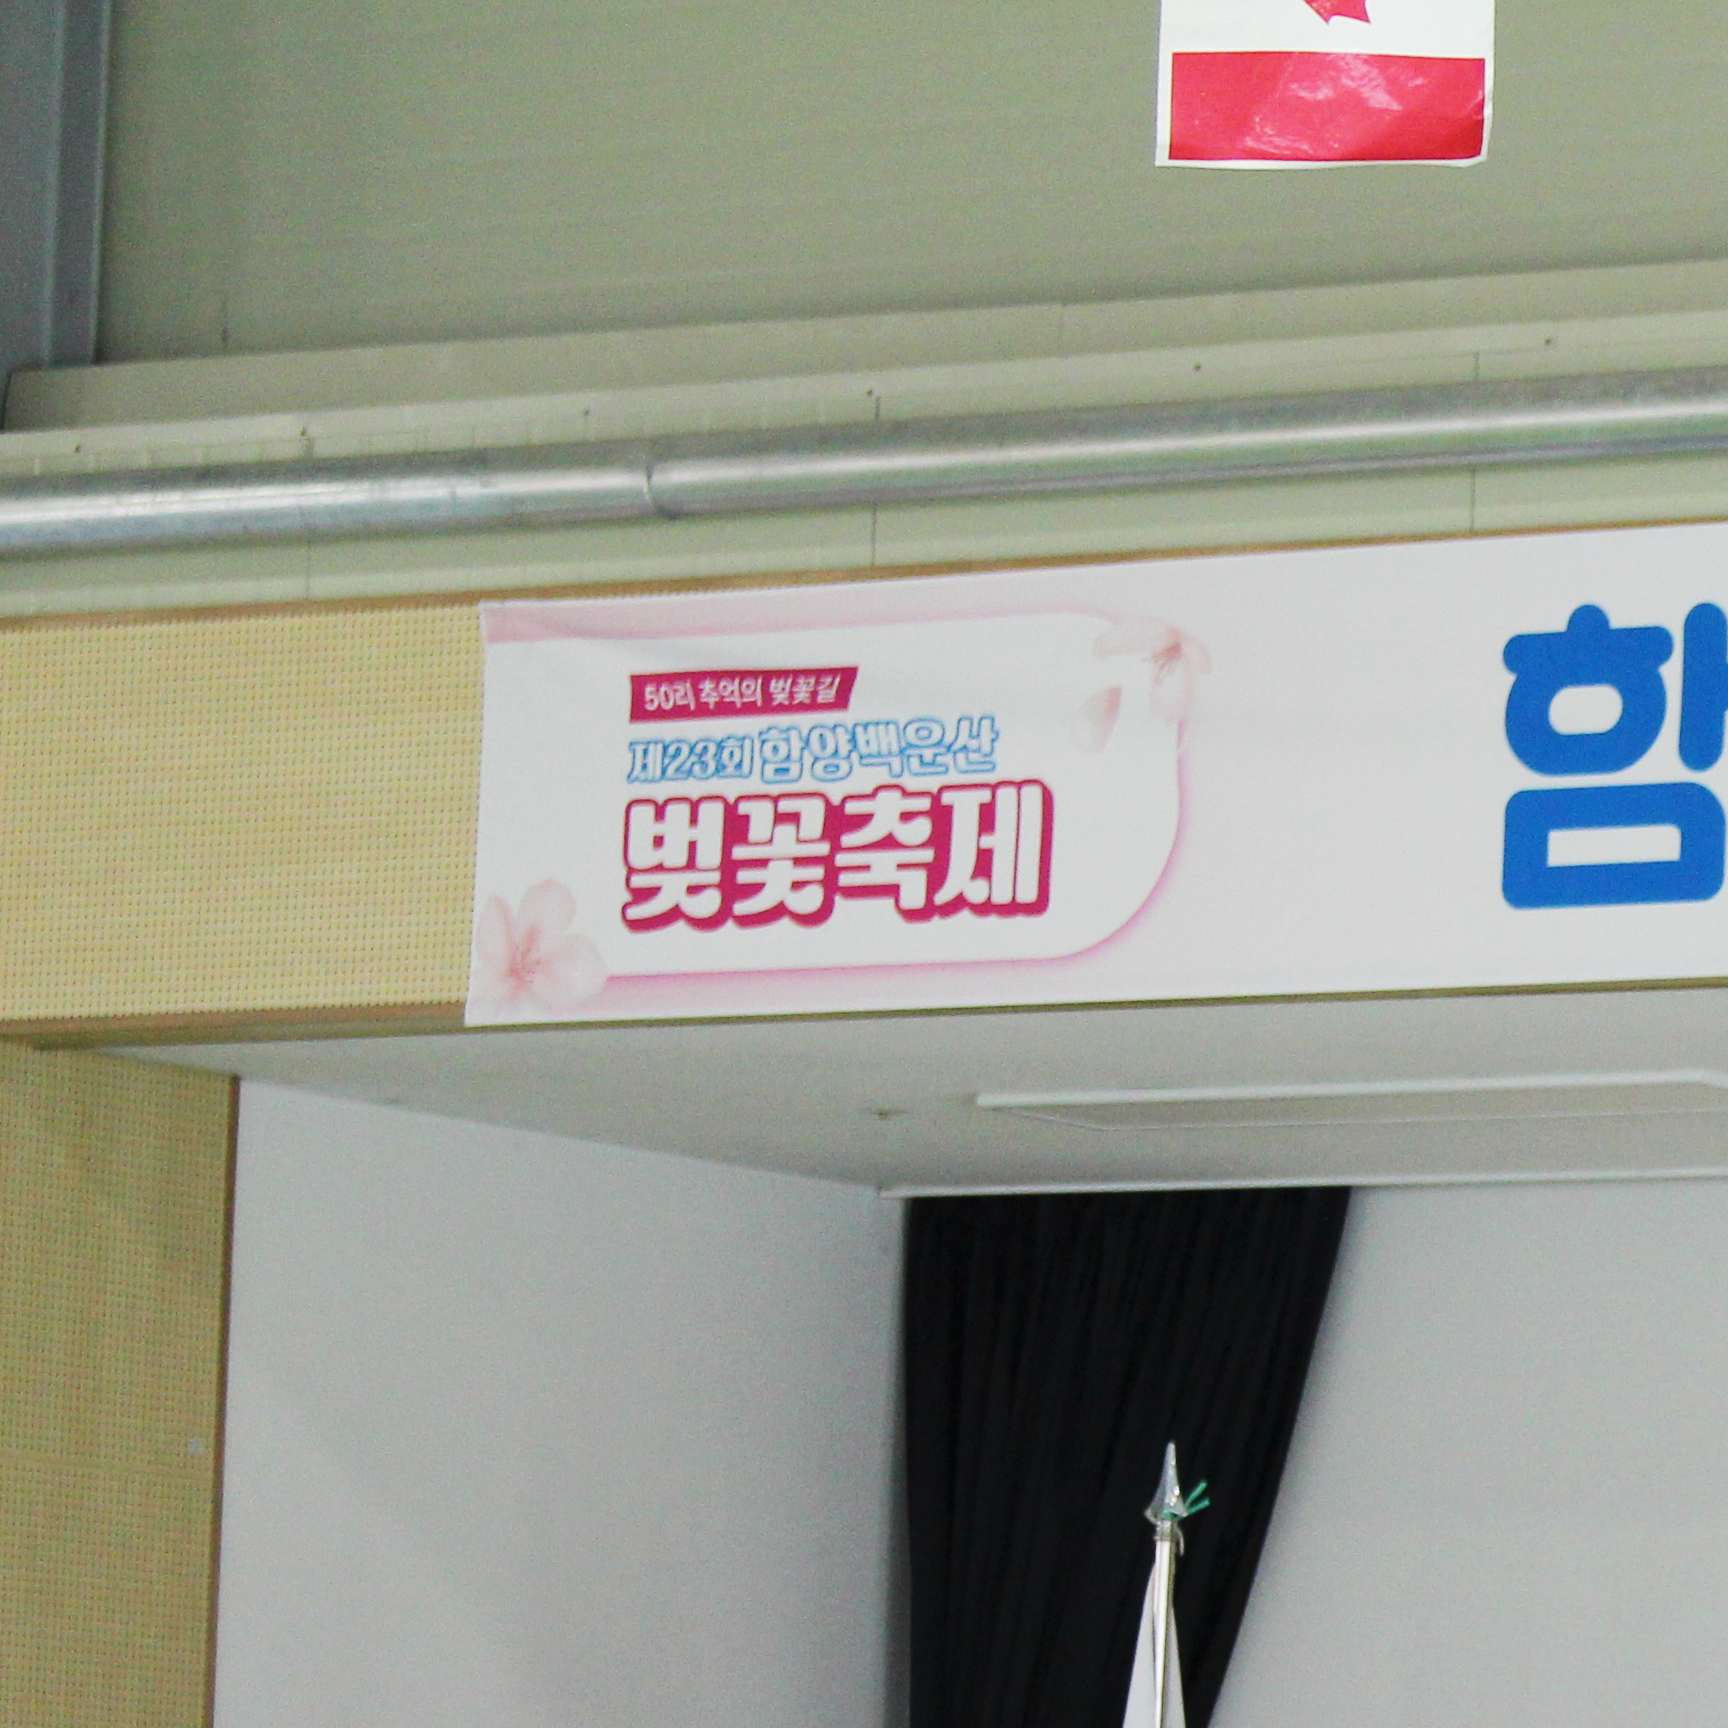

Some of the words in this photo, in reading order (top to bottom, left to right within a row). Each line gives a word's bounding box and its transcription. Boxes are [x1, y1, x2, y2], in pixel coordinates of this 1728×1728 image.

[644, 679, 695, 711] 50리
[699, 676, 762, 708] 추억의
[769, 673, 840, 705] 벚꽃길
[622, 779, 1053, 932] 벚꽃축제
